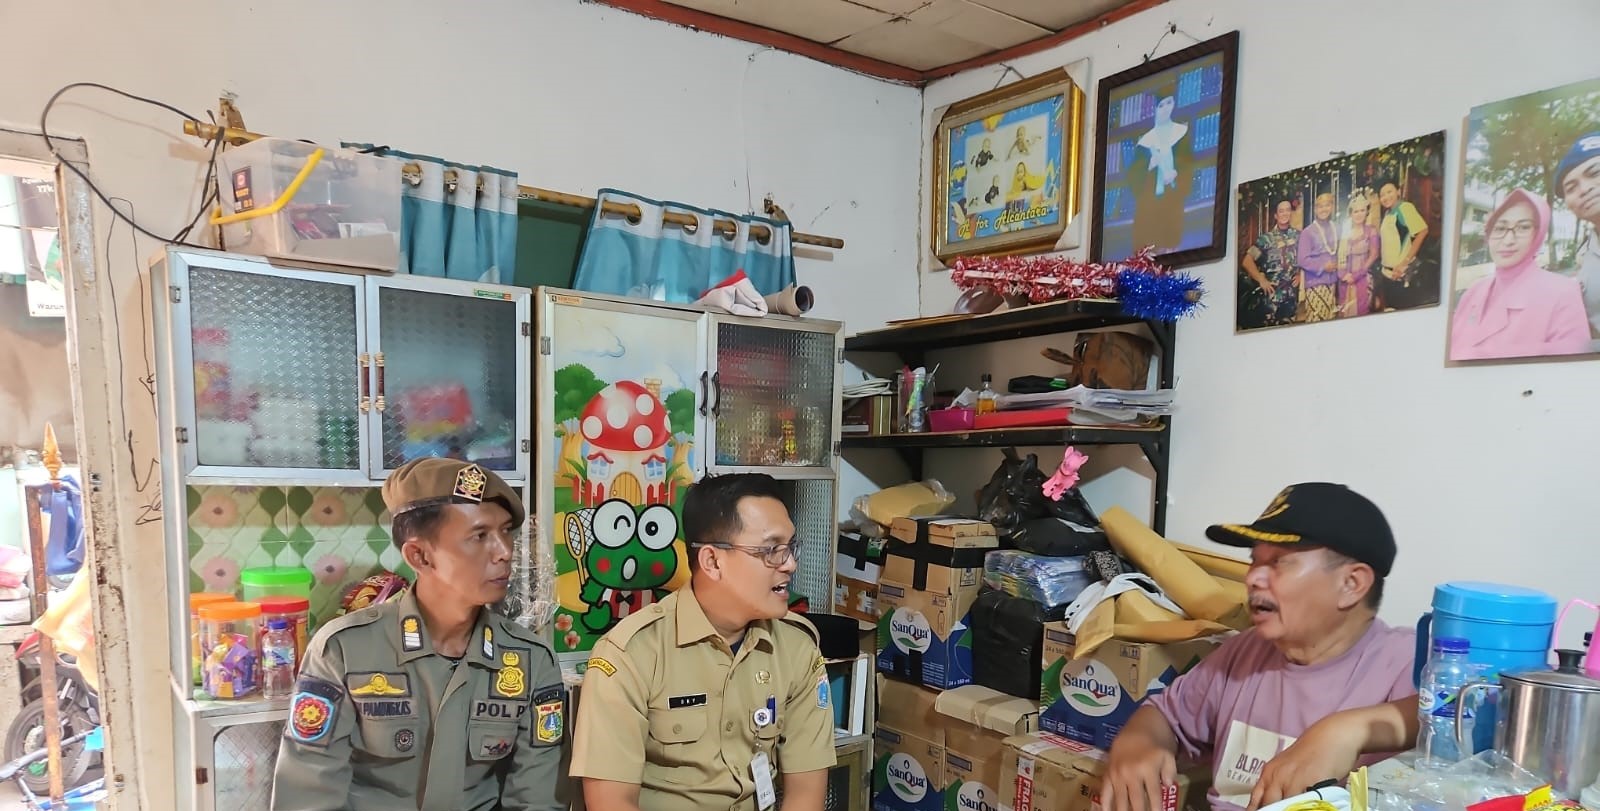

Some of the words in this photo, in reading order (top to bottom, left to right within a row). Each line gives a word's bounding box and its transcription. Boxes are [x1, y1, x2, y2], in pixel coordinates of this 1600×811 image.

[975, 216, 988, 236] for
[993, 205, 1049, 231] Alcantara
[892, 620, 928, 639] SanQua
[1063, 672, 1118, 698] SanQua
[476, 702, 511, 717] POL
[888, 765, 925, 788] SanQua
